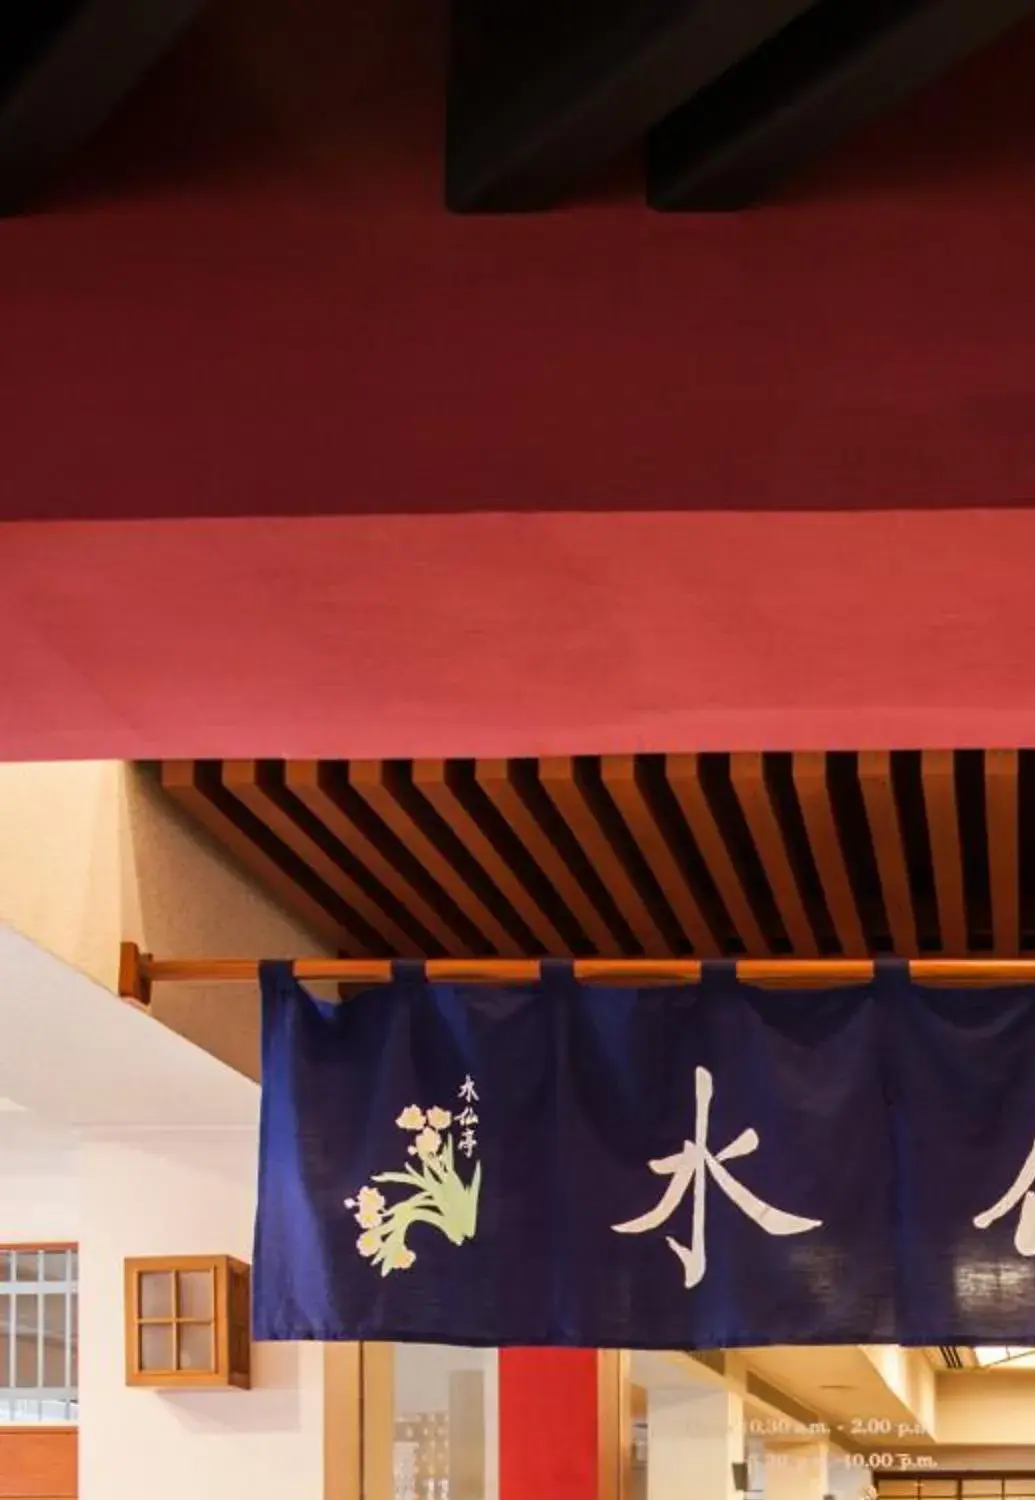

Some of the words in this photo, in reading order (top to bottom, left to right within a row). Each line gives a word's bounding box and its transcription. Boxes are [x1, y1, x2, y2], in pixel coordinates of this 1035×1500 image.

[454, 1073, 480, 1158] 水仙亭
[743, 1418, 788, 1435] 0.30
[850, 1417, 891, 1434] 2.00
[845, 1452, 893, 1468] 10.00
[899, 1454, 938, 1471] p.m.
